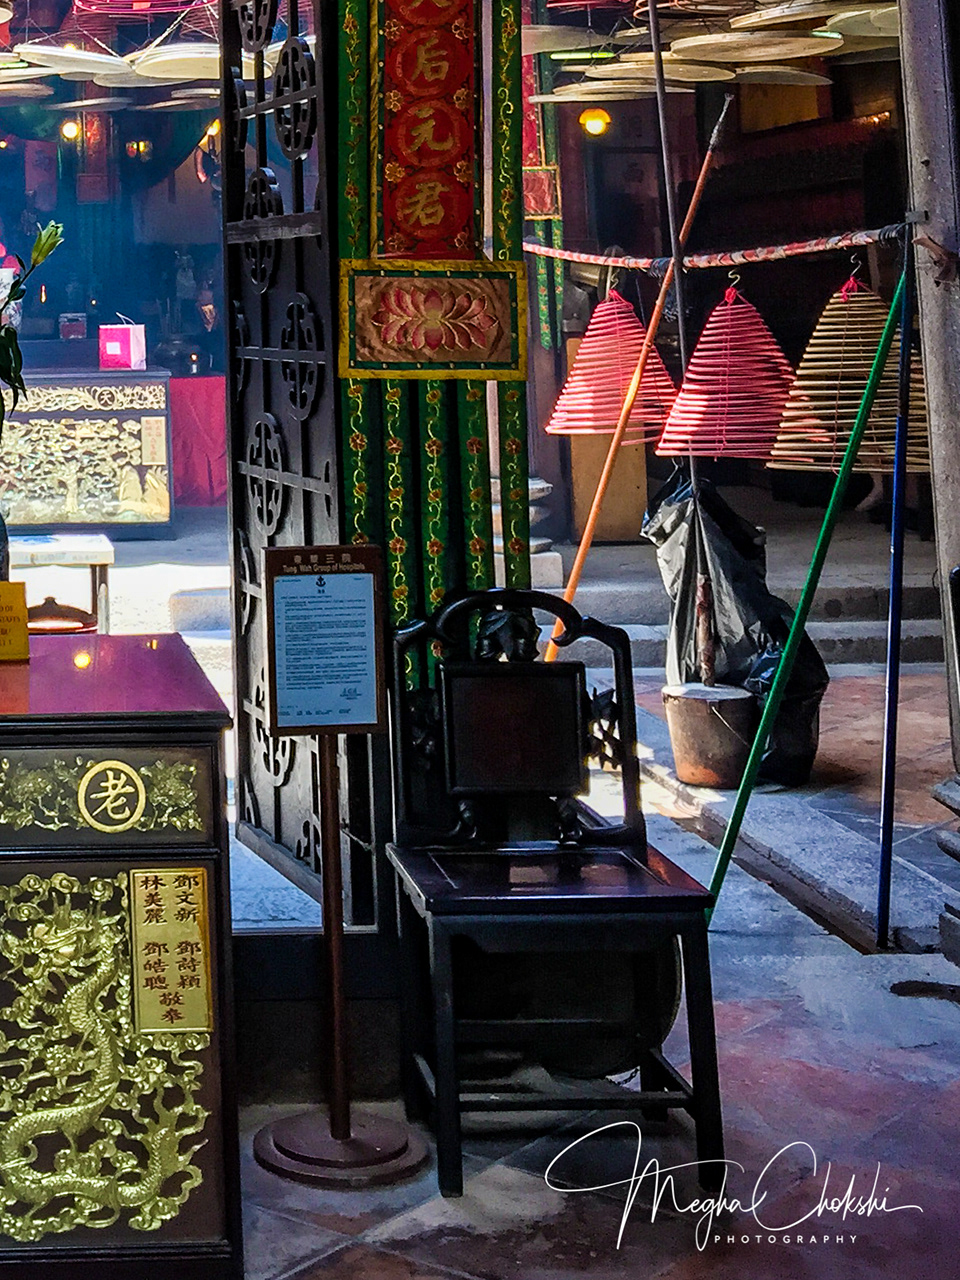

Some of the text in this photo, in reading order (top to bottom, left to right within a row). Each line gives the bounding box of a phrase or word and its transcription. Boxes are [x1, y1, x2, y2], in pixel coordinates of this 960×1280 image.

[283, 564, 297, 574] Tung
[313, 563, 331, 573] Group
[139, 874, 168, 926] 林美麗
[173, 874, 200, 924] 鄧文新
[159, 991, 185, 1024] 敬奉
